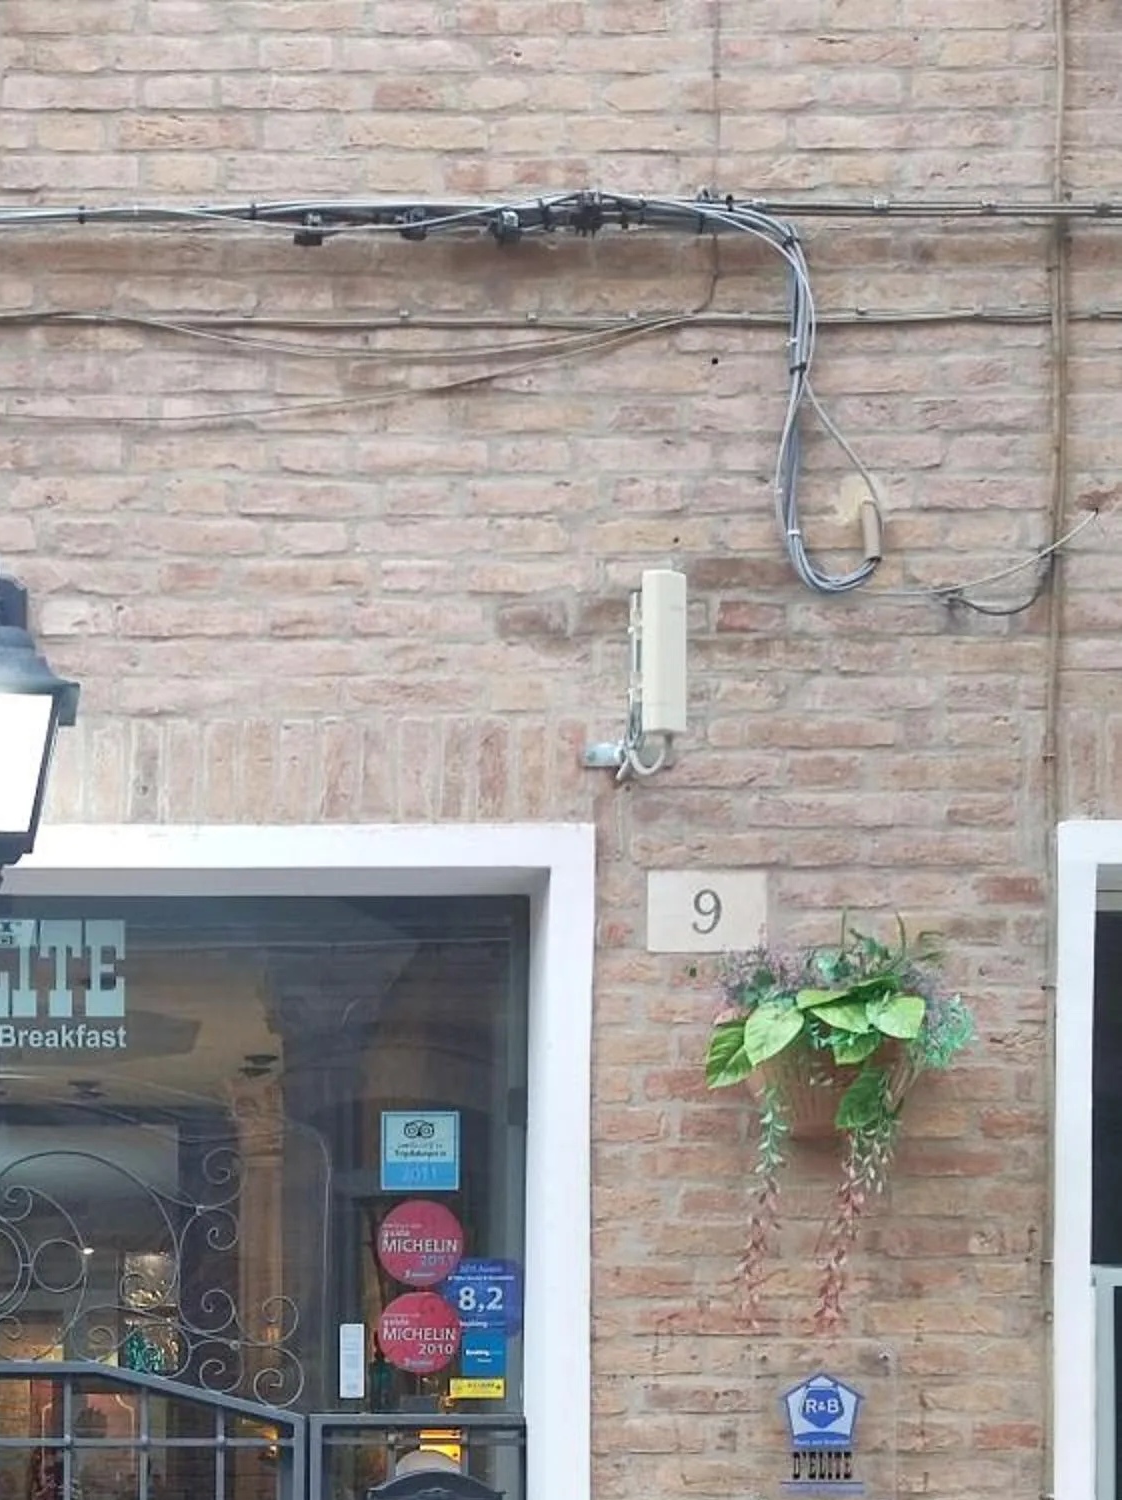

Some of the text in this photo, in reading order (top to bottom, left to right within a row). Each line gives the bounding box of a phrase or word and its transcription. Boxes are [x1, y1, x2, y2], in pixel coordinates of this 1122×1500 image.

[691, 889, 722, 934] 9
[381, 1239, 457, 1253] MICHELIN
[458, 1286, 503, 1312] 8,2
[382, 1327, 456, 1341] MICHELIN
[418, 1343, 454, 1355] 2010
[805, 1398, 839, 1413] R&B
